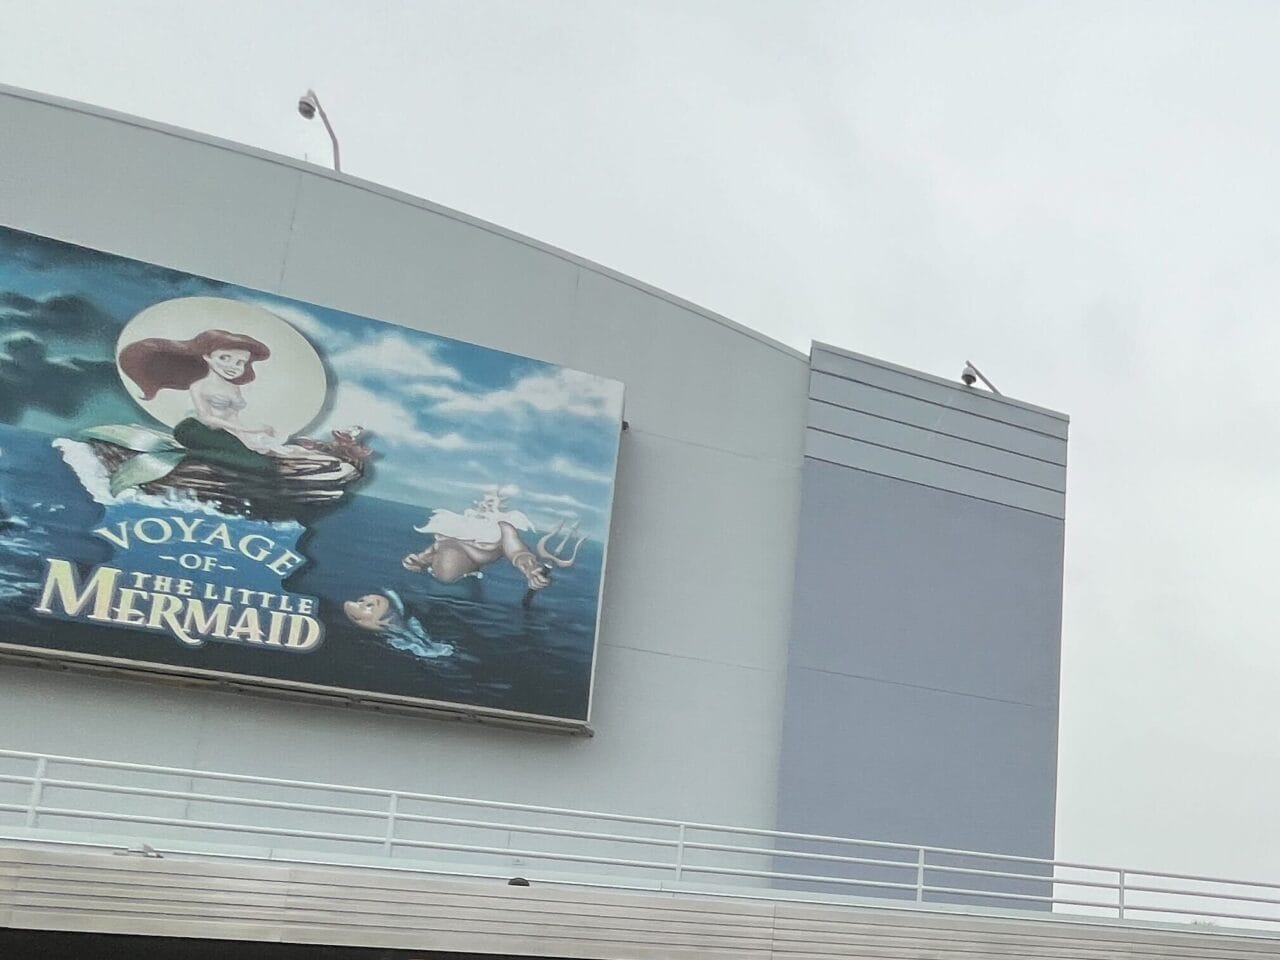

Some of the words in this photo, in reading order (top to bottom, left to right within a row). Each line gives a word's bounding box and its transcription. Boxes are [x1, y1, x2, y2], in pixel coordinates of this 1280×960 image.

[93, 516, 307, 576] VOYAGE
[179, 553, 219, 571] OF
[34, 558, 321, 646] MERMAID
[131, 571, 194, 597] THE
[203, 583, 313, 615] LITTLE
